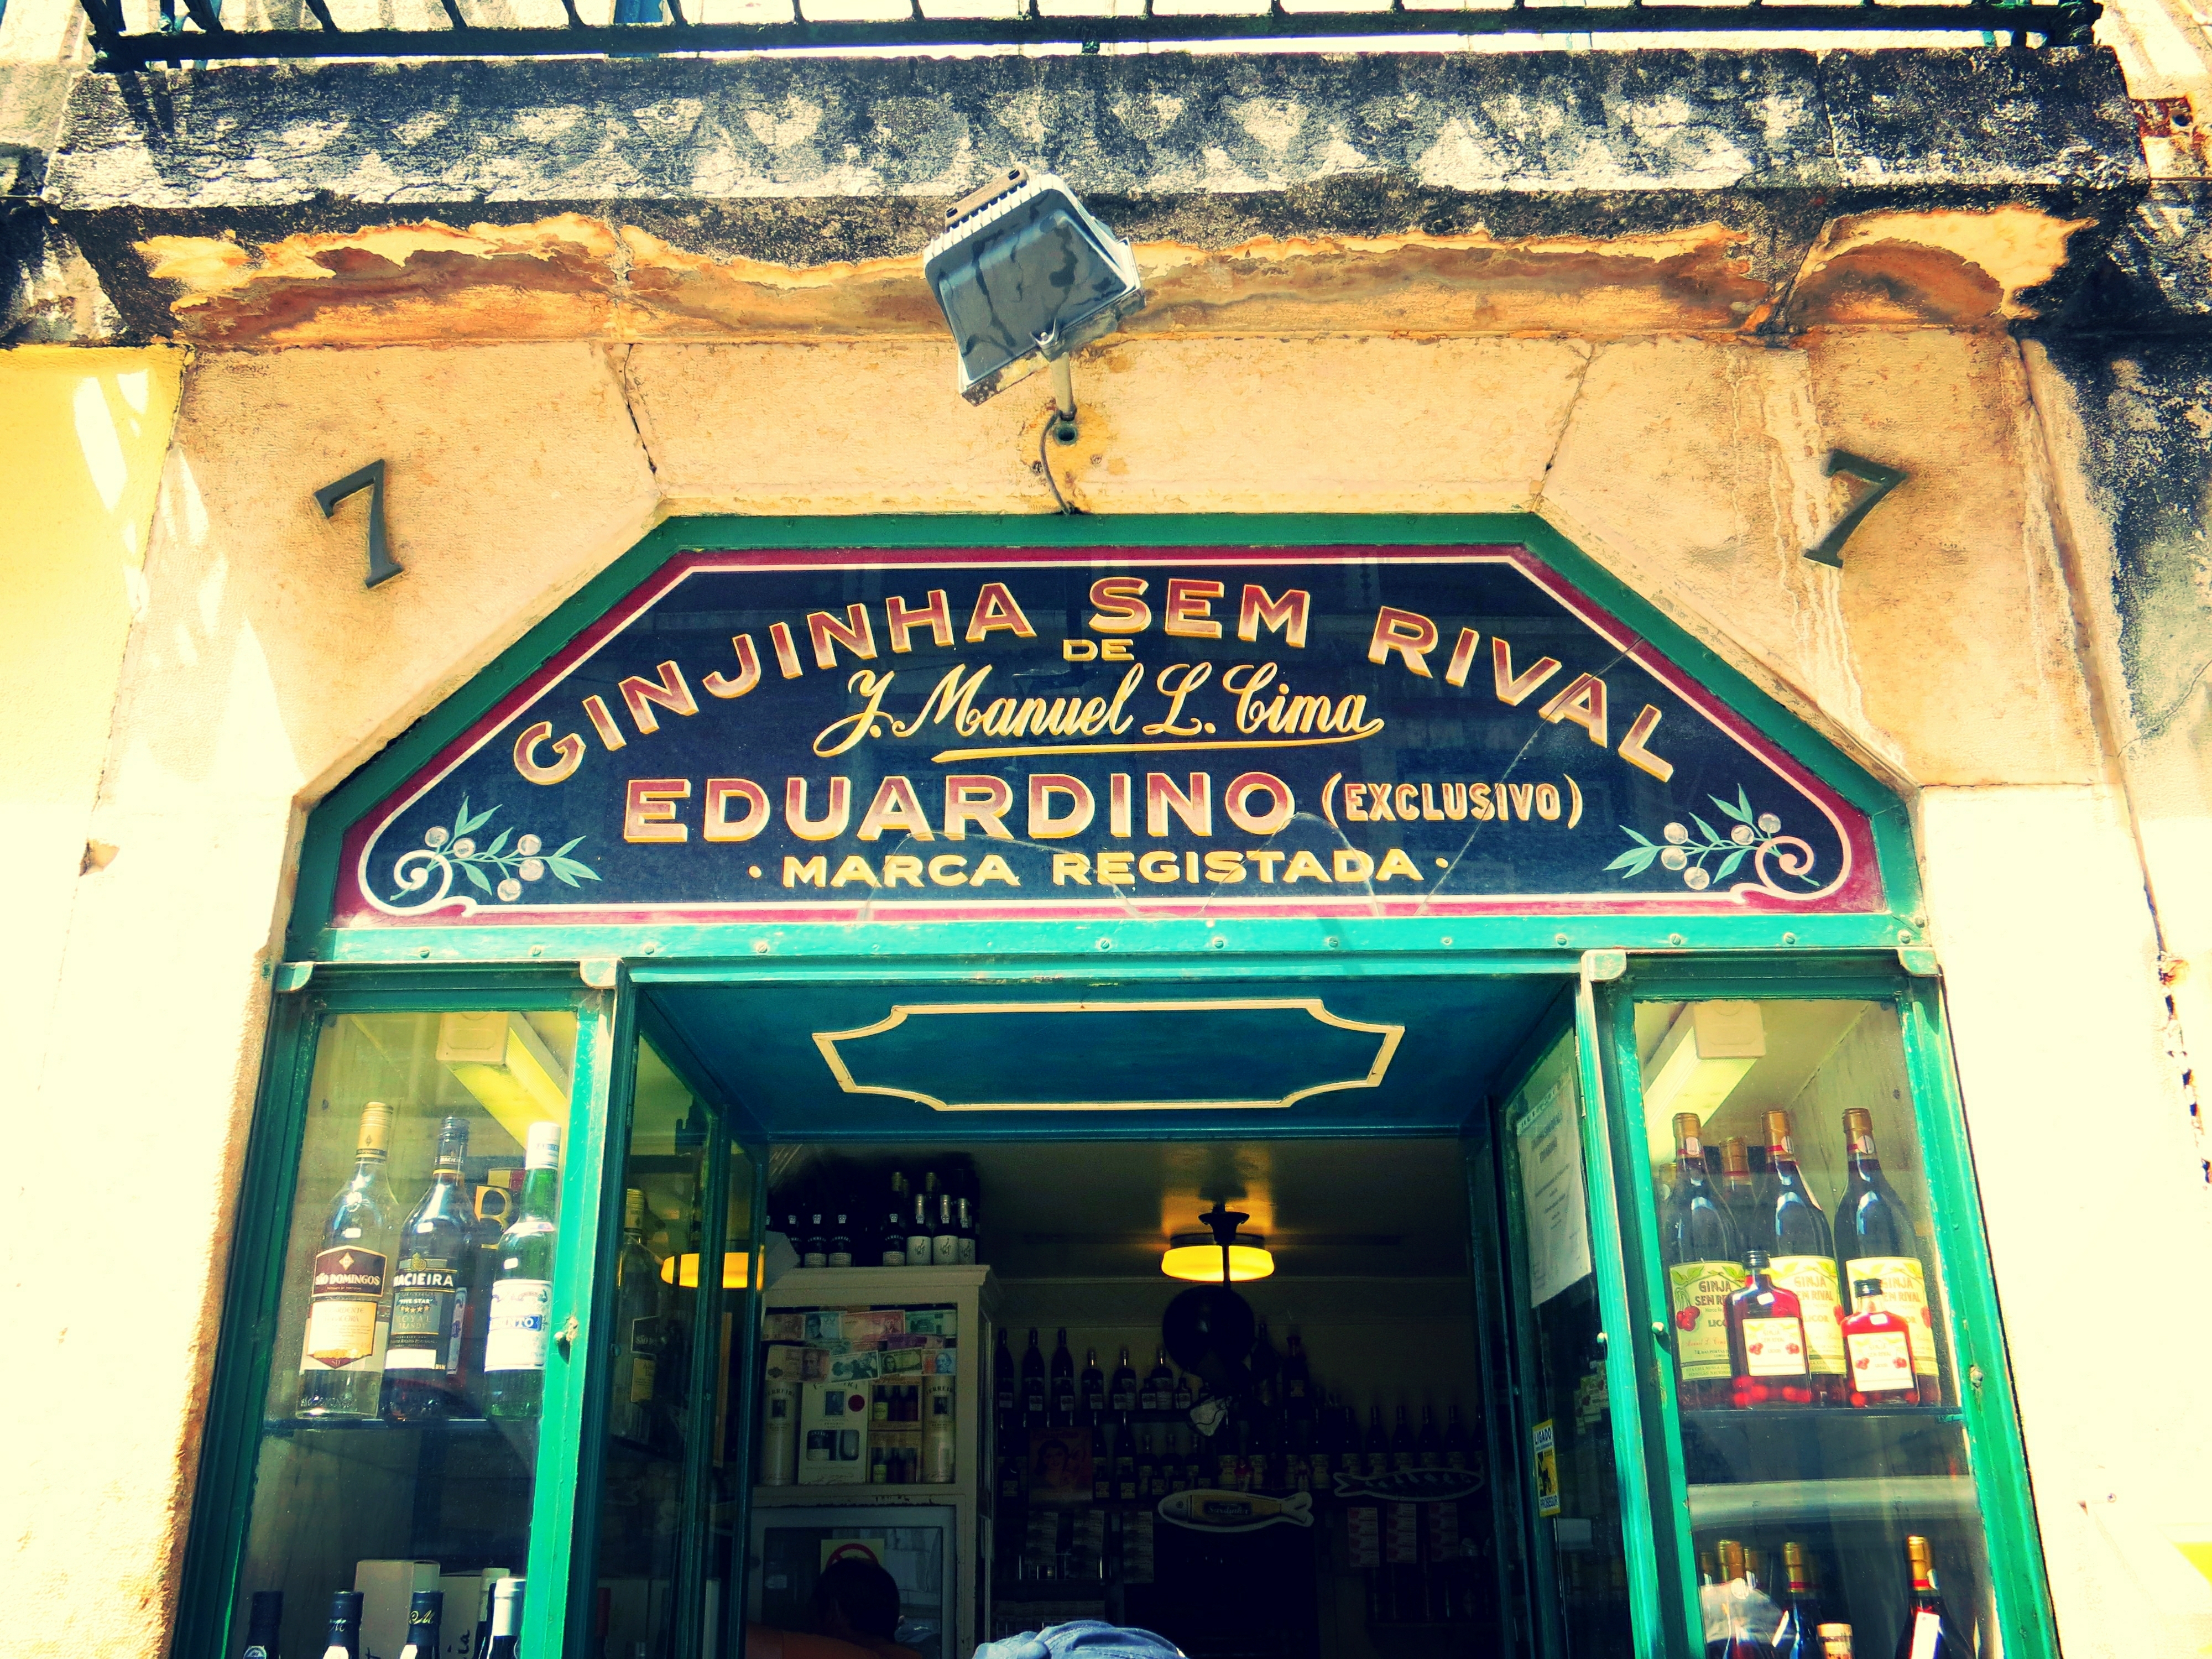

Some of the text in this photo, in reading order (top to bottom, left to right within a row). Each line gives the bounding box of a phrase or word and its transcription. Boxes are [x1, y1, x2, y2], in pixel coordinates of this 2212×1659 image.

[313, 458, 404, 588] 7
[1803, 448, 1907, 568] 7
[1062, 638, 1135, 661] DE
[513, 576, 1674, 785] GINJINHA SEM RIVAL
[891, 662, 1145, 738] Manuel
[1222, 662, 1385, 737] Cima
[623, 771, 1583, 843] EDUARDINO (EXCLUSIVO)
[782, 848, 1424, 888] MARCA REGISTADA
[330, 1274, 381, 1286] DOMINGOS
[1698, 1280, 1732, 1293] GINJA
[1793, 1276, 1827, 1288] GINJA
[1796, 1291, 1834, 1301] EM RIVAL
